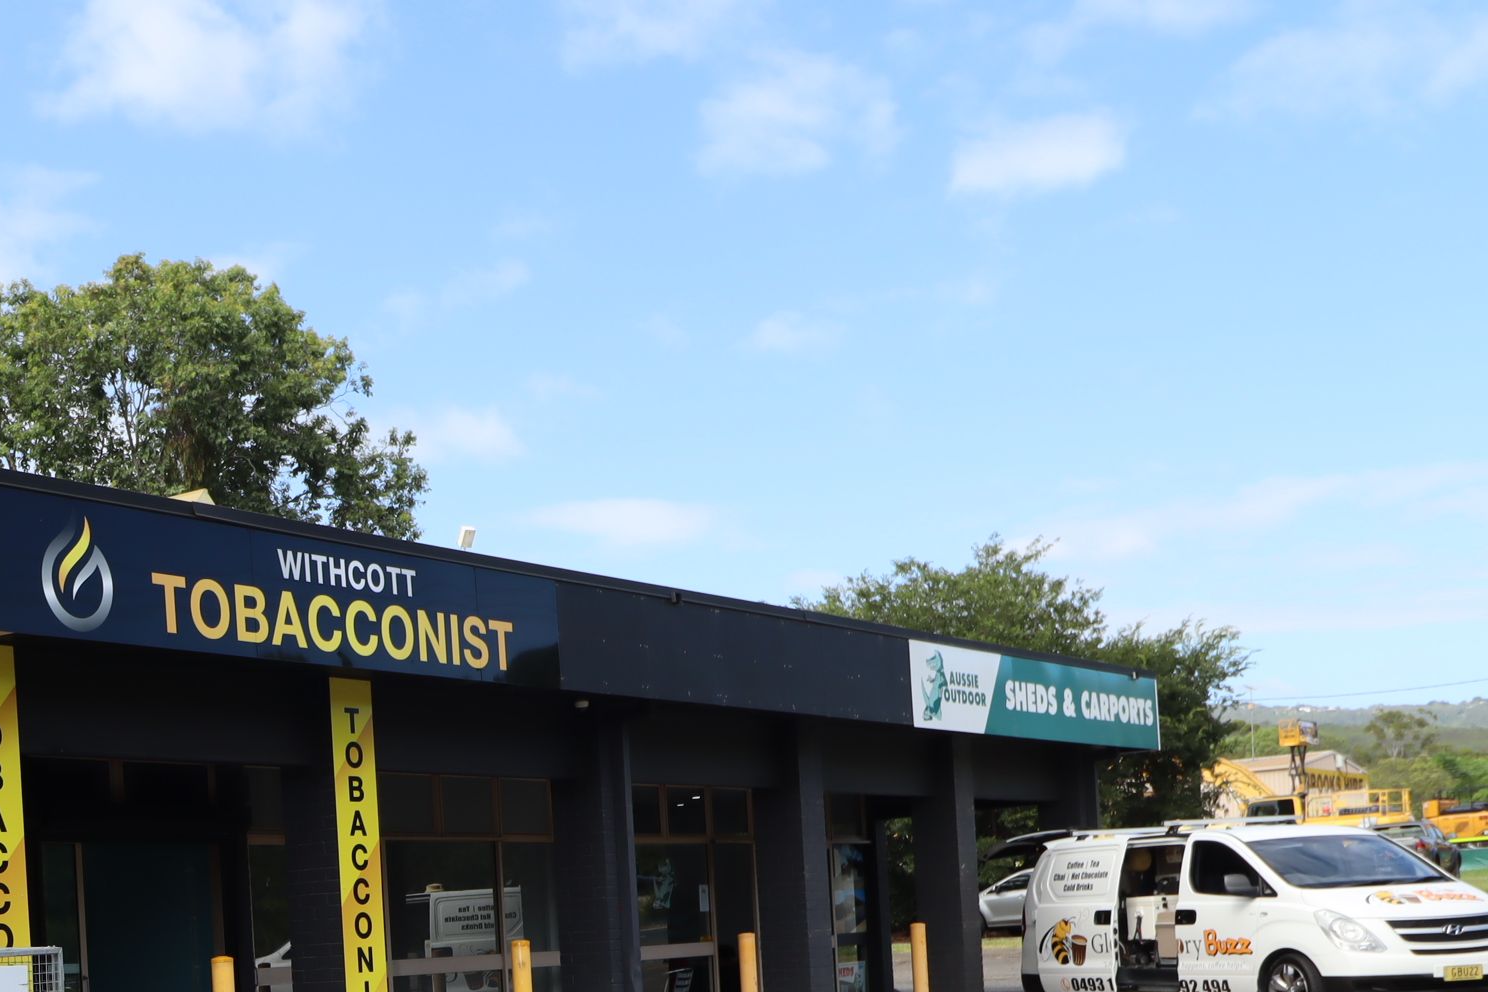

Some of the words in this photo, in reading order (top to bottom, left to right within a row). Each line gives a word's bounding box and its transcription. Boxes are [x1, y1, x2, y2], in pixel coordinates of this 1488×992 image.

[277, 549, 416, 597] WITHCOTT
[152, 572, 512, 671] TOBACCONIST
[949, 671, 979, 687] AUSSIE
[943, 688, 986, 707] OUTDOOR
[1005, 680, 1058, 715] SHEDS
[1062, 687, 1076, 718] &
[1081, 690, 1154, 727] CARPORTS
[1067, 861, 1084, 869] Coffee
[1090, 860, 1100, 868] Tea
[1053, 873, 1066, 881] Chai
[1081, 870, 1109, 880] Chocolate
[1063, 884, 1075, 892] Cold
[1076, 883, 1094, 891] Drinks
[1071, 977, 1105, 992] 0493
